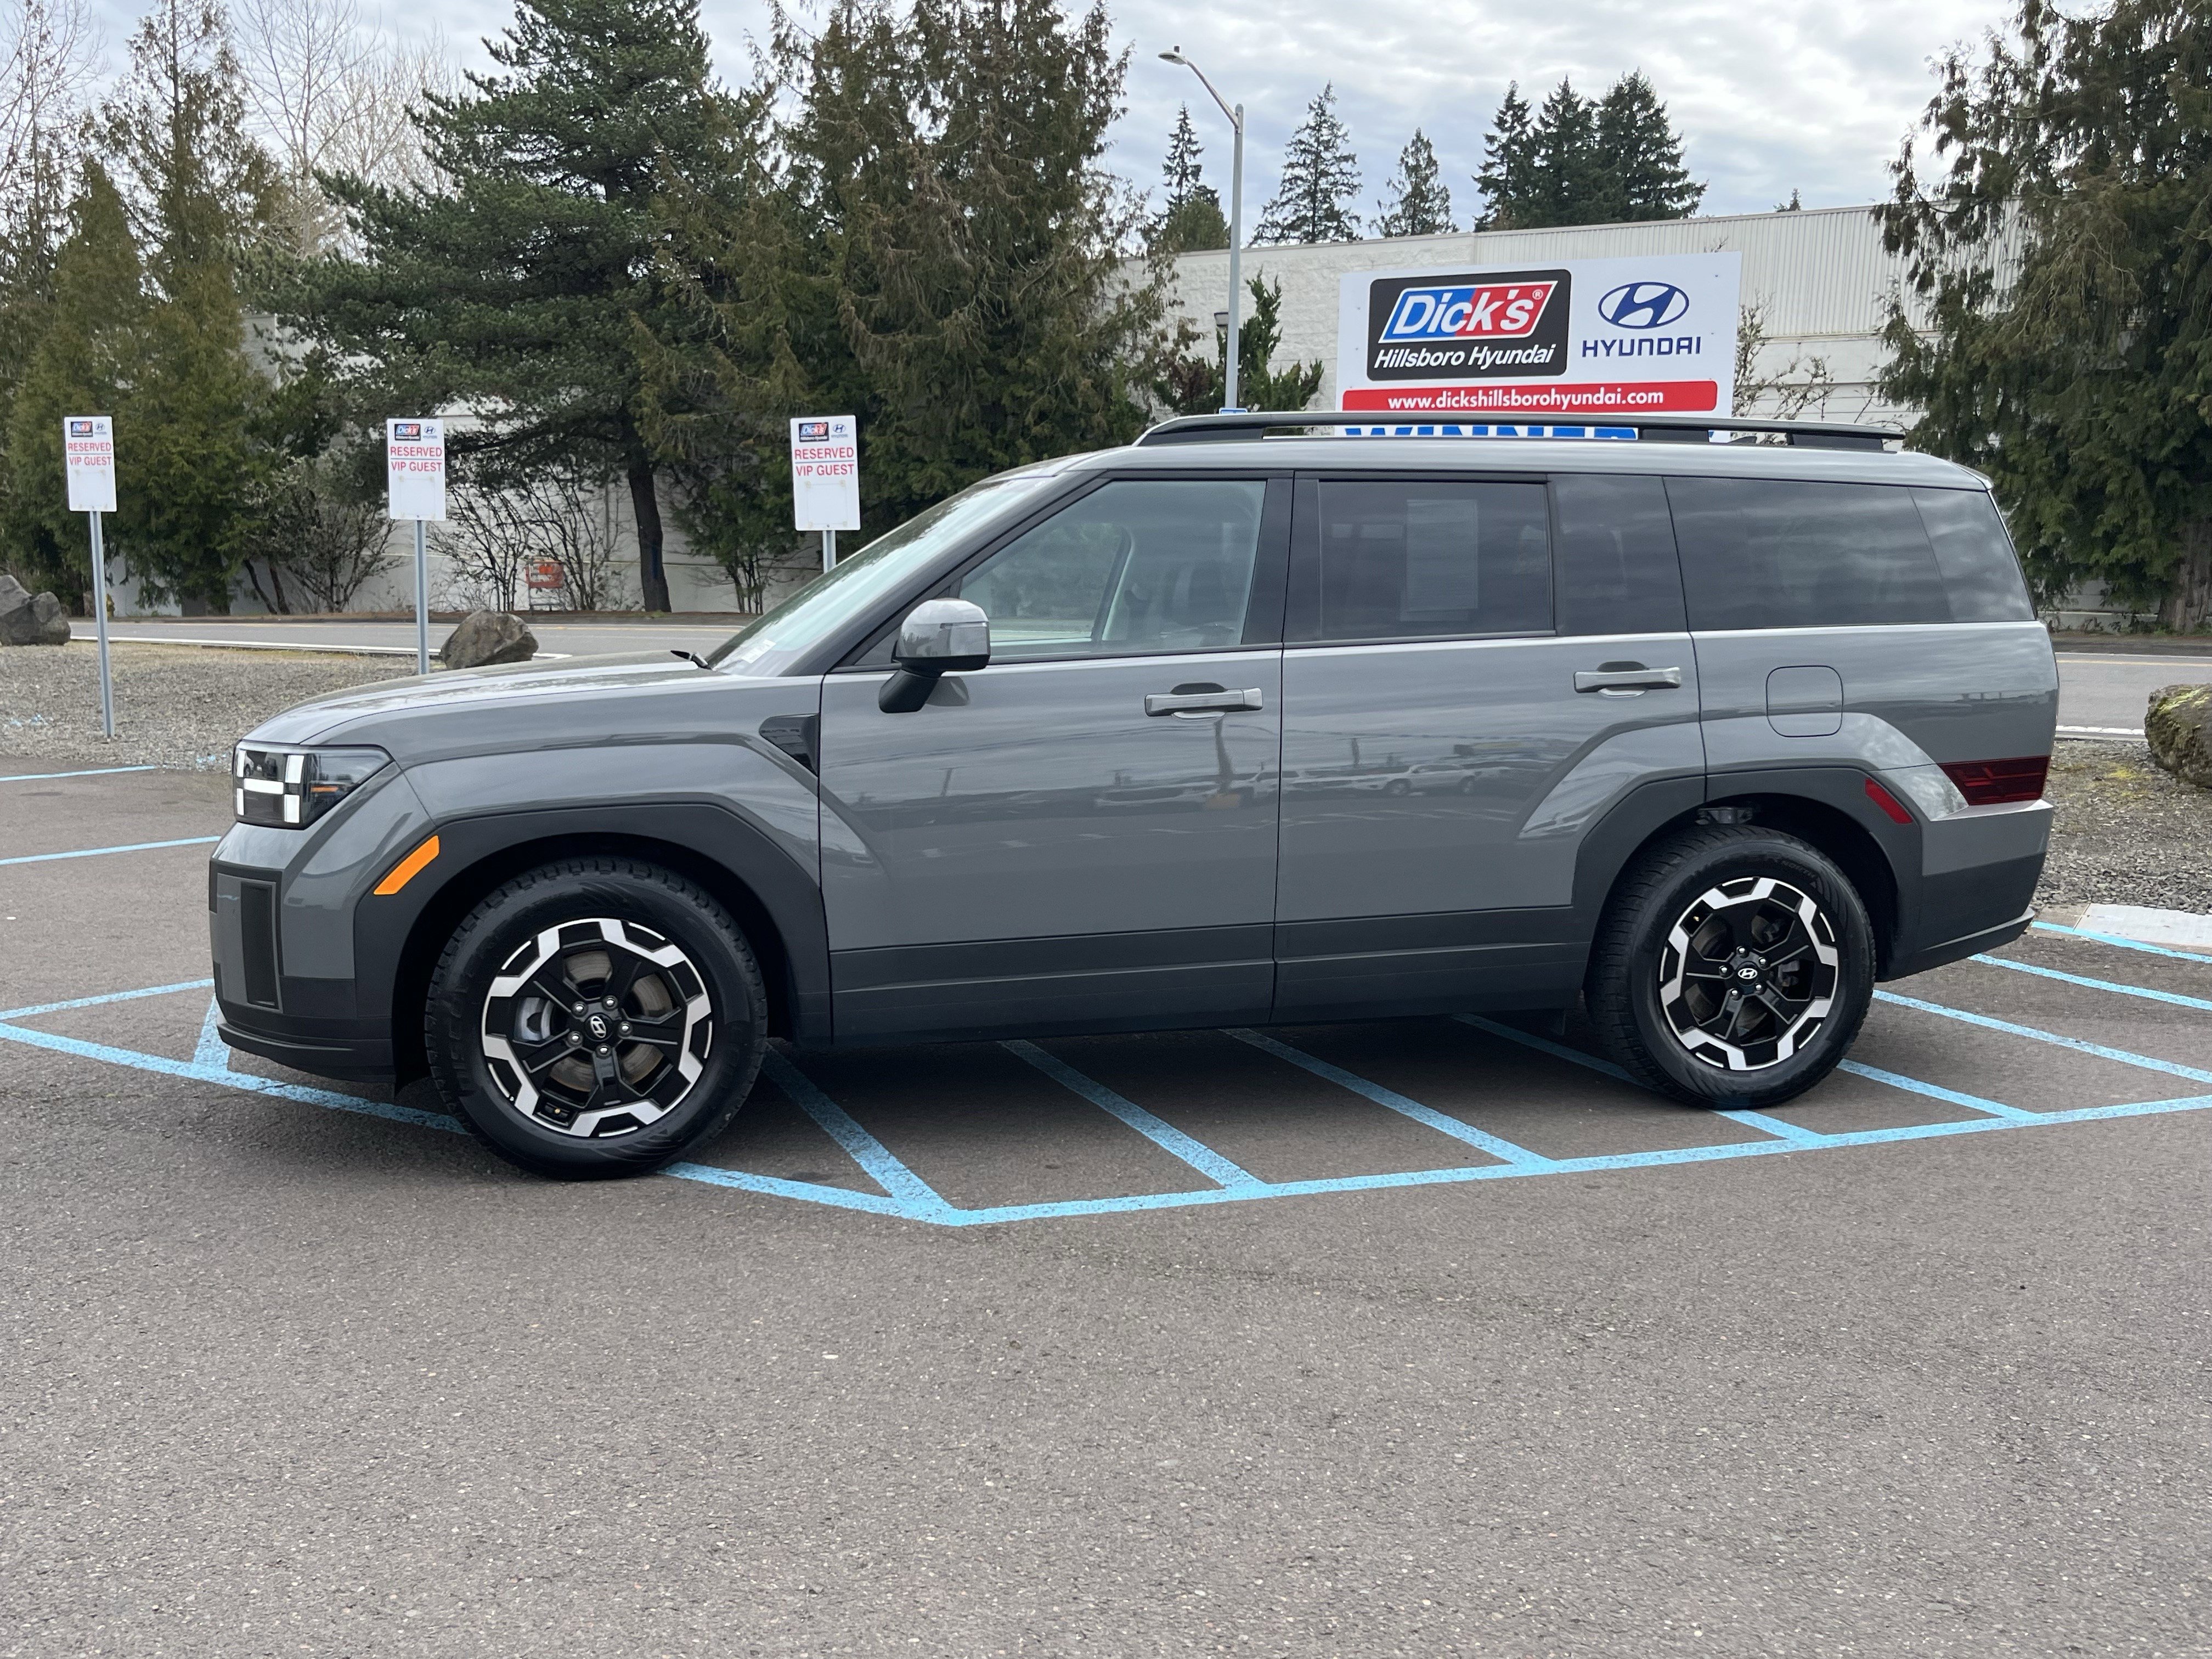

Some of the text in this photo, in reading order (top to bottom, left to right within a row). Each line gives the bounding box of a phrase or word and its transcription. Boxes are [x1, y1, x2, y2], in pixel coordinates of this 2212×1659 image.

[1582, 336, 1701, 357] HYUNDAI
[1374, 344, 1556, 370] Hillsboro Hyundai
[1388, 387, 1663, 410] www.dickshillsborohyundai.com
[68, 442, 111, 452] RESERVED
[390, 447, 442, 456] RESERVED
[794, 447, 854, 459] RESERVED
[69, 456, 111, 466] VIP GUEST
[391, 461, 442, 472] VIP GUEST
[796, 464, 854, 476] VIP GUEST
